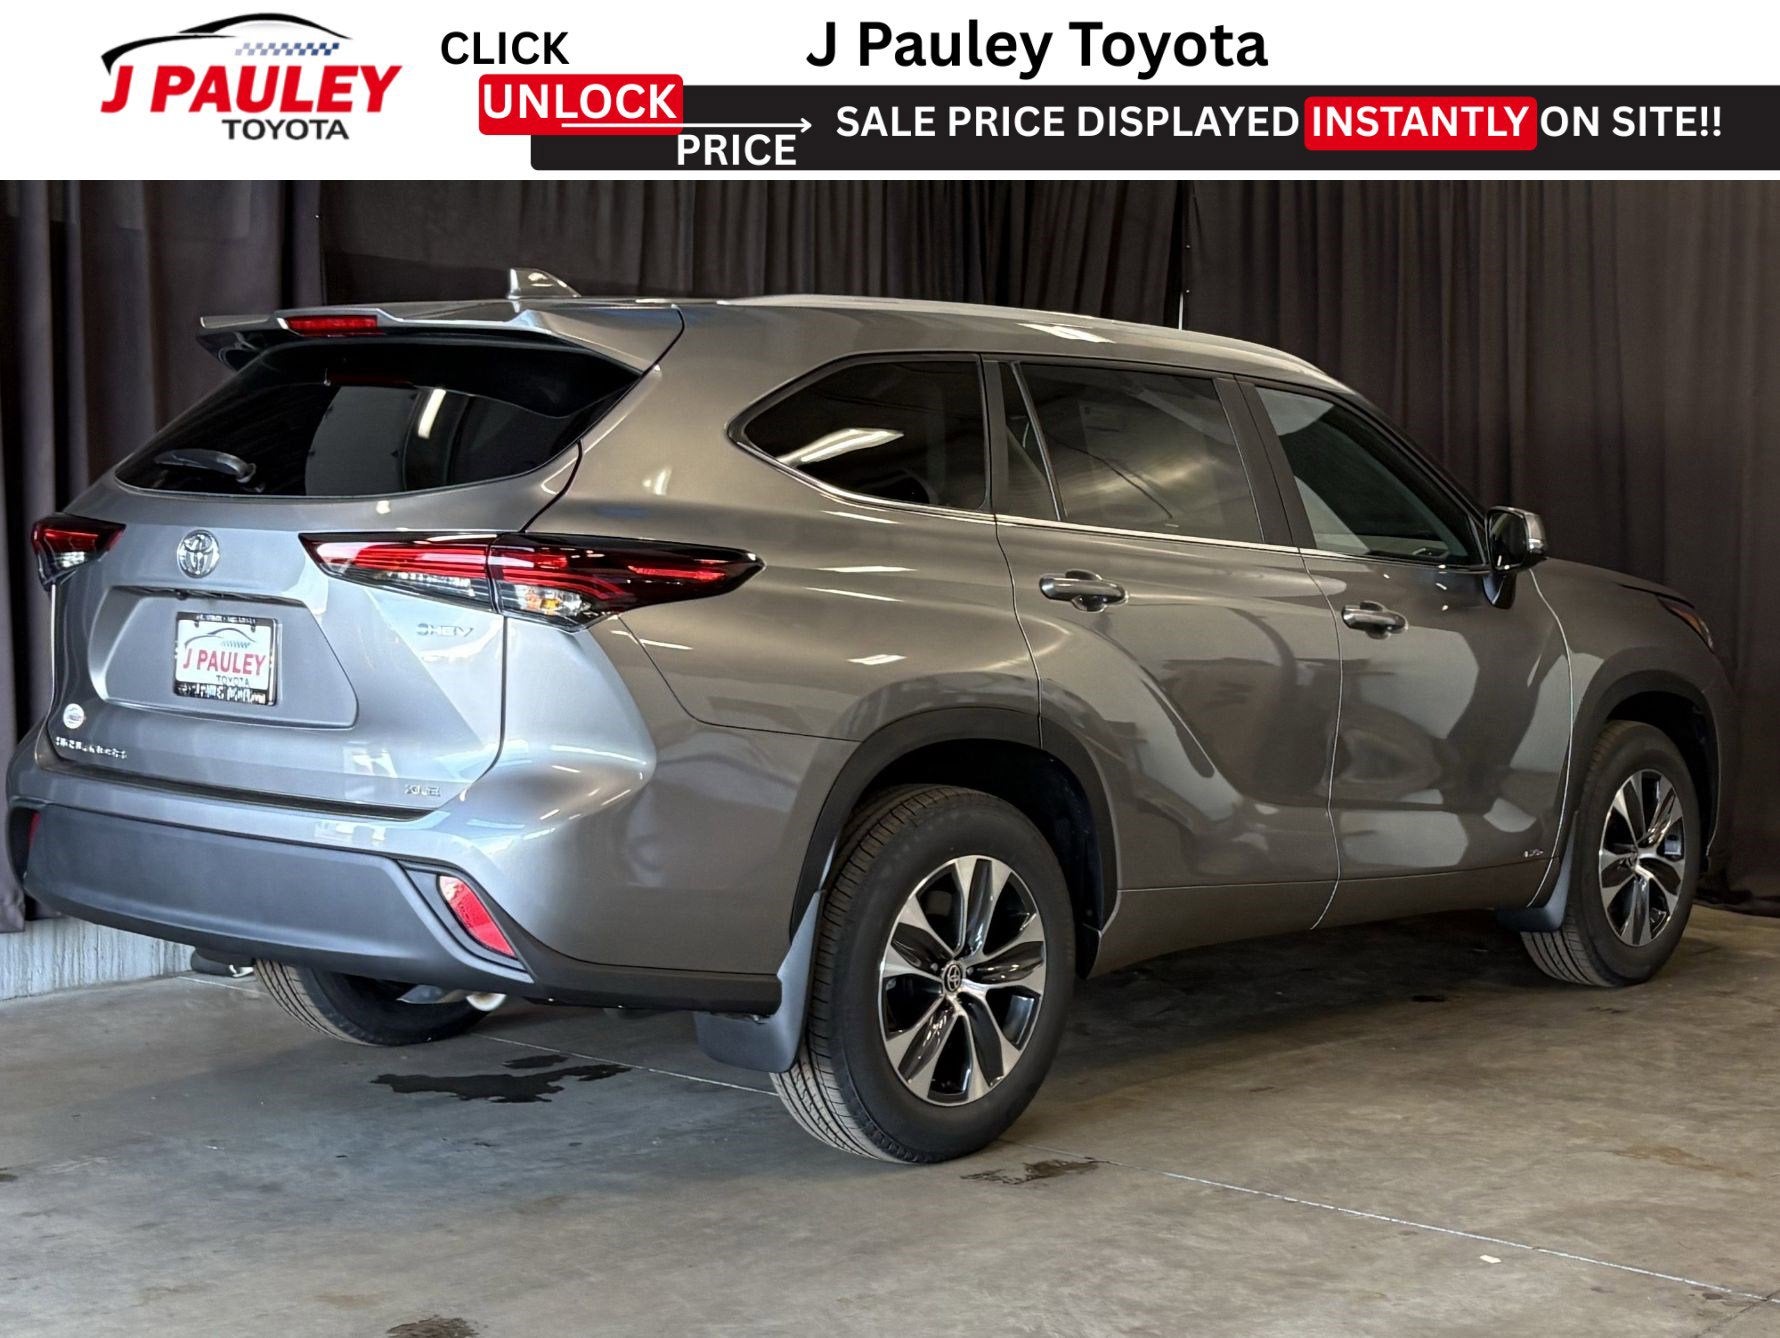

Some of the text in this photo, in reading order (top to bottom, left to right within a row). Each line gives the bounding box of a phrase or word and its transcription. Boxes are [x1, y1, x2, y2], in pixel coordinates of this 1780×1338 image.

[182, 648, 267, 676] J PAULEY
[216, 674, 250, 686] TOYOTA
